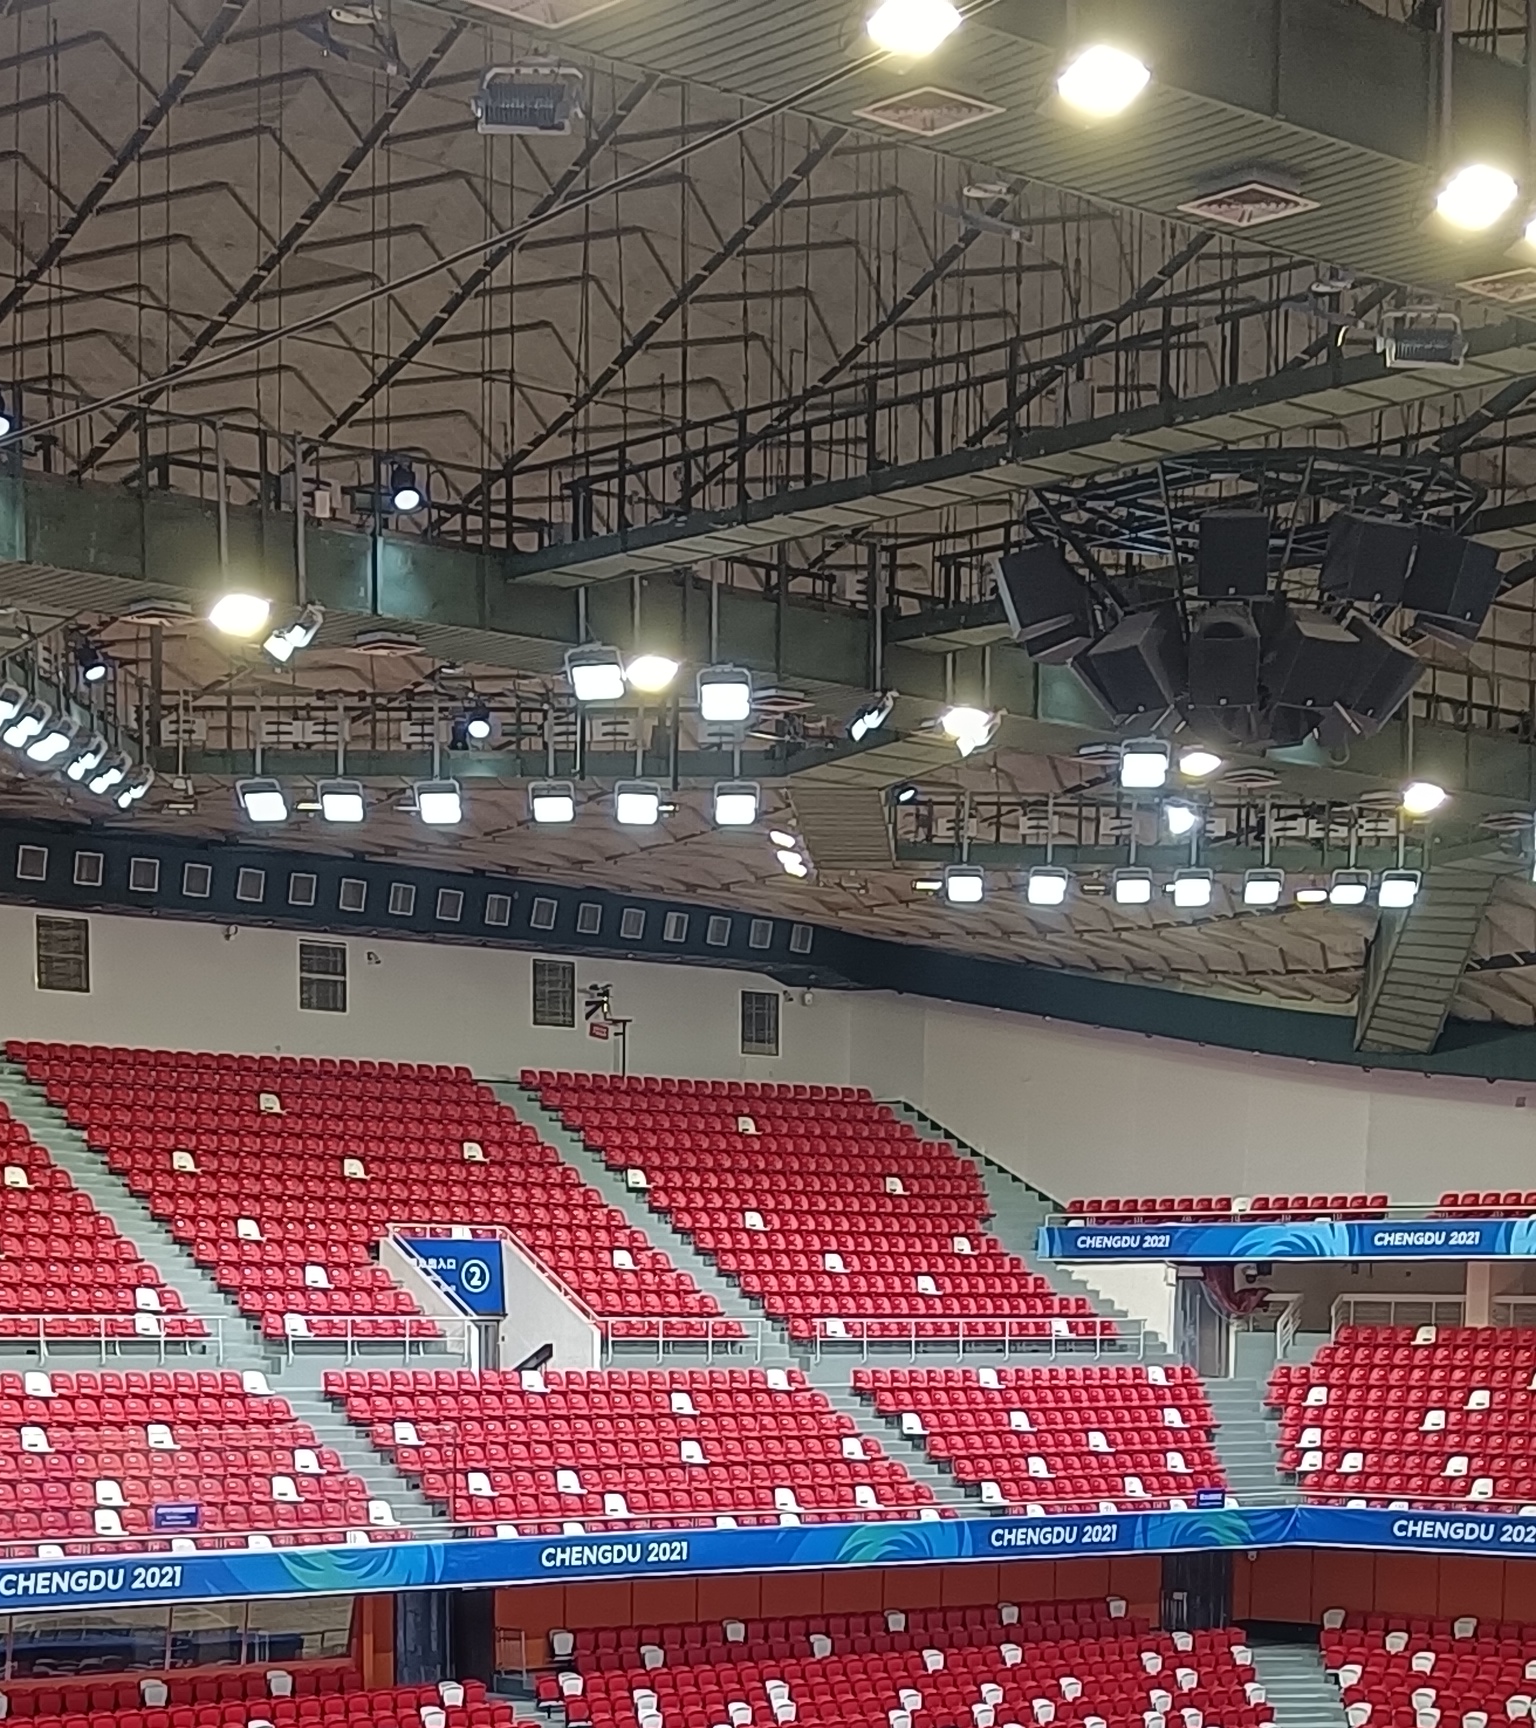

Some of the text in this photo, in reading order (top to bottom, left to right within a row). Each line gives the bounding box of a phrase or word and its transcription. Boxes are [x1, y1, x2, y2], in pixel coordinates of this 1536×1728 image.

[1076, 1234, 1171, 1249] CHENGDU 2021
[1373, 1231, 1481, 1246] CHENGDU 2021
[990, 1523, 1118, 1547] CHENGDU 2021
[1392, 1518, 1495, 1542] CHENGDU
[541, 1541, 688, 1567] CHENGDU 2021
[130, 1565, 183, 1590] 2021
